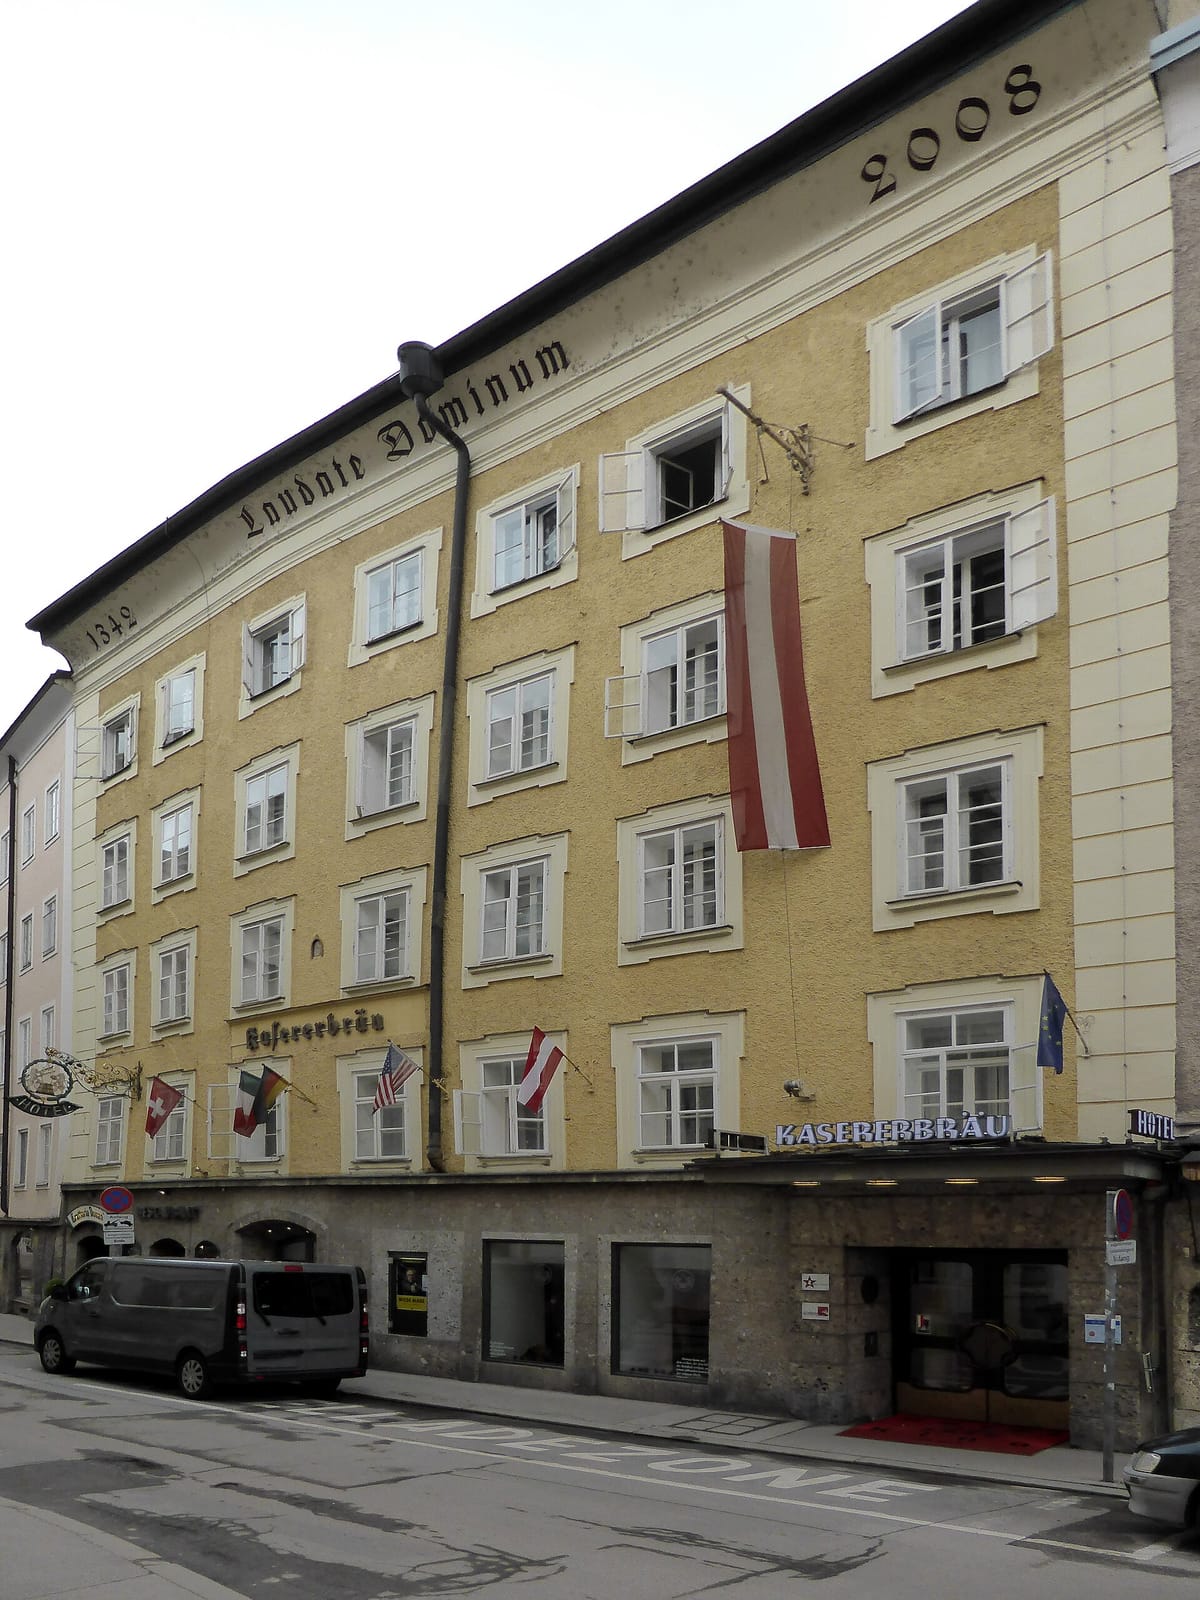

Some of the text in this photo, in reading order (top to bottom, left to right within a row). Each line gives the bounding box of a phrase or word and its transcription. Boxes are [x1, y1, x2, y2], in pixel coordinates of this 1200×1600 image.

[861, 64, 1042, 205] 2008
[239, 340, 571, 539] Laudate Dominum
[86, 606, 138, 651] 1342
[18, 1097, 69, 1116] HOTEL
[1138, 1110, 1175, 1139] HOTEL
[775, 1110, 1010, 1146] KASERERBRÄU
